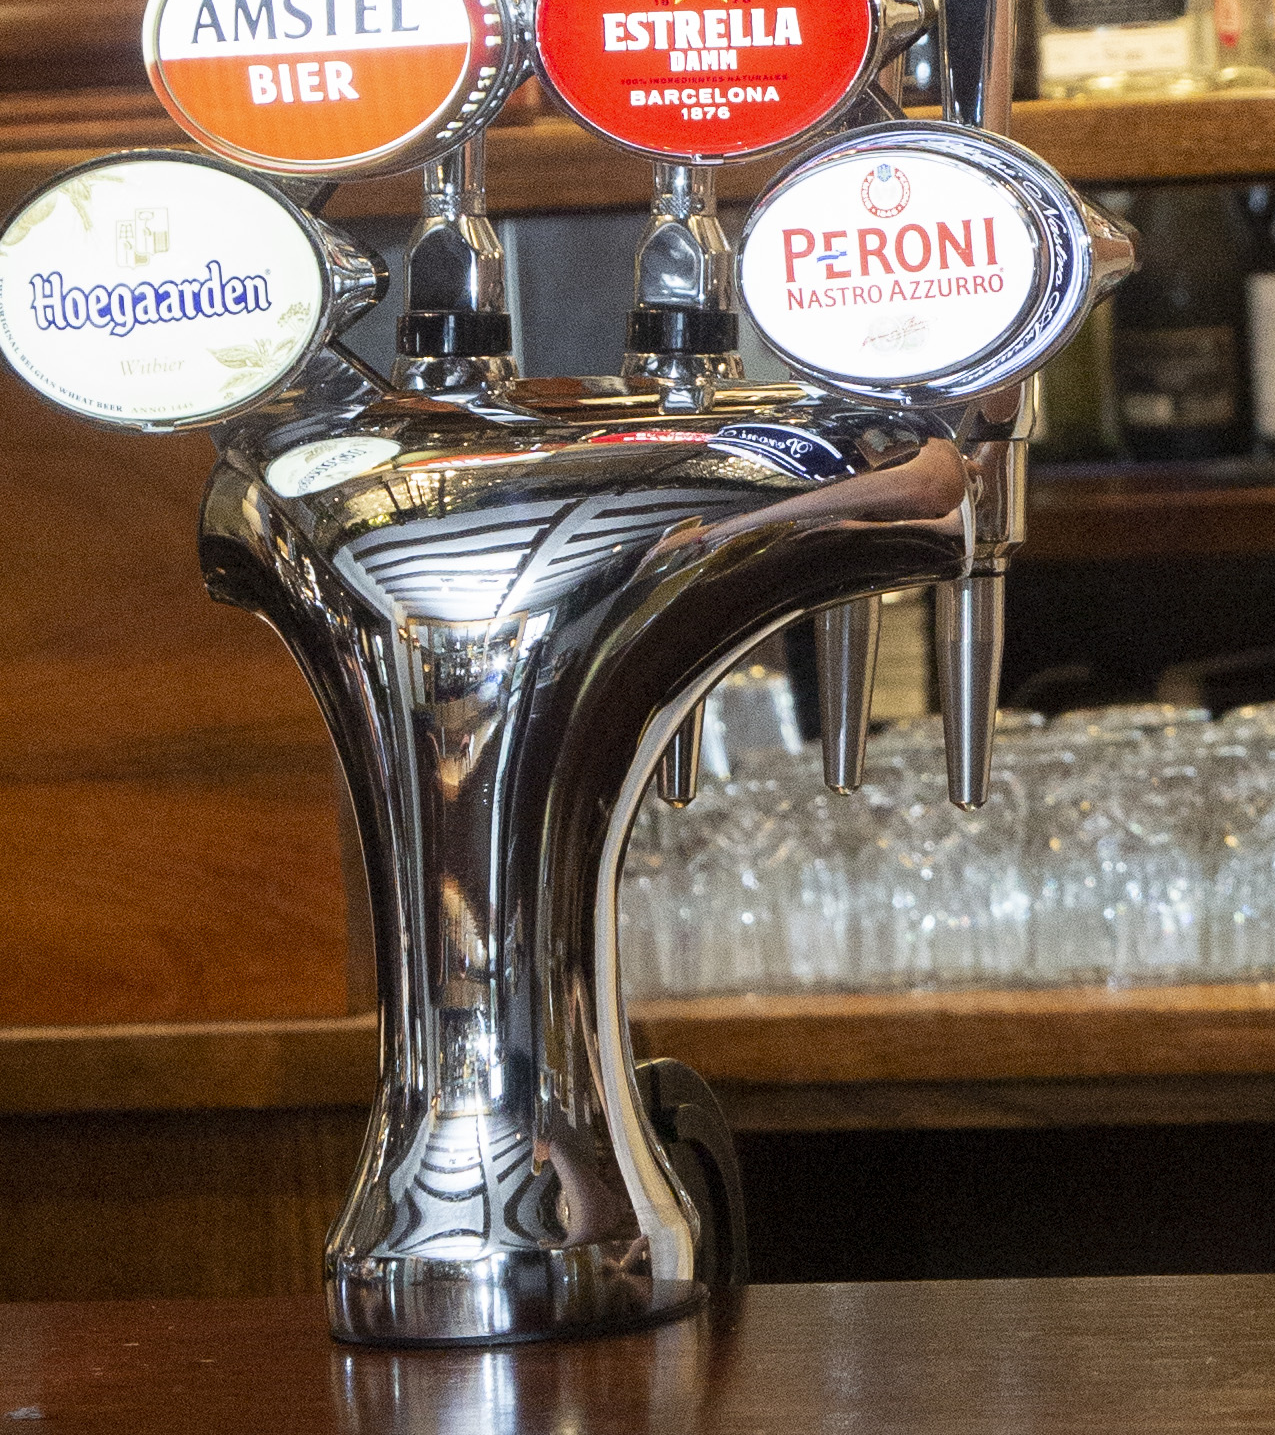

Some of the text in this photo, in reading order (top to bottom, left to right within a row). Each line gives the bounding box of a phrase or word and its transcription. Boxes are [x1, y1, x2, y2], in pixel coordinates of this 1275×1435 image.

[602, 6, 803, 52] ESTRELLA
[669, 49, 738, 72] DAMM
[248, 60, 360, 105] BIER
[630, 86, 780, 107] BARCELONA
[681, 106, 731, 121] 1876
[782, 217, 998, 284] PERONI
[28, 259, 272, 338] Hoegaarden
[786, 273, 1005, 311] NASTRO AZZURRO
[120, 357, 185, 377] Witbier
[97, 400, 123, 413] BEER
